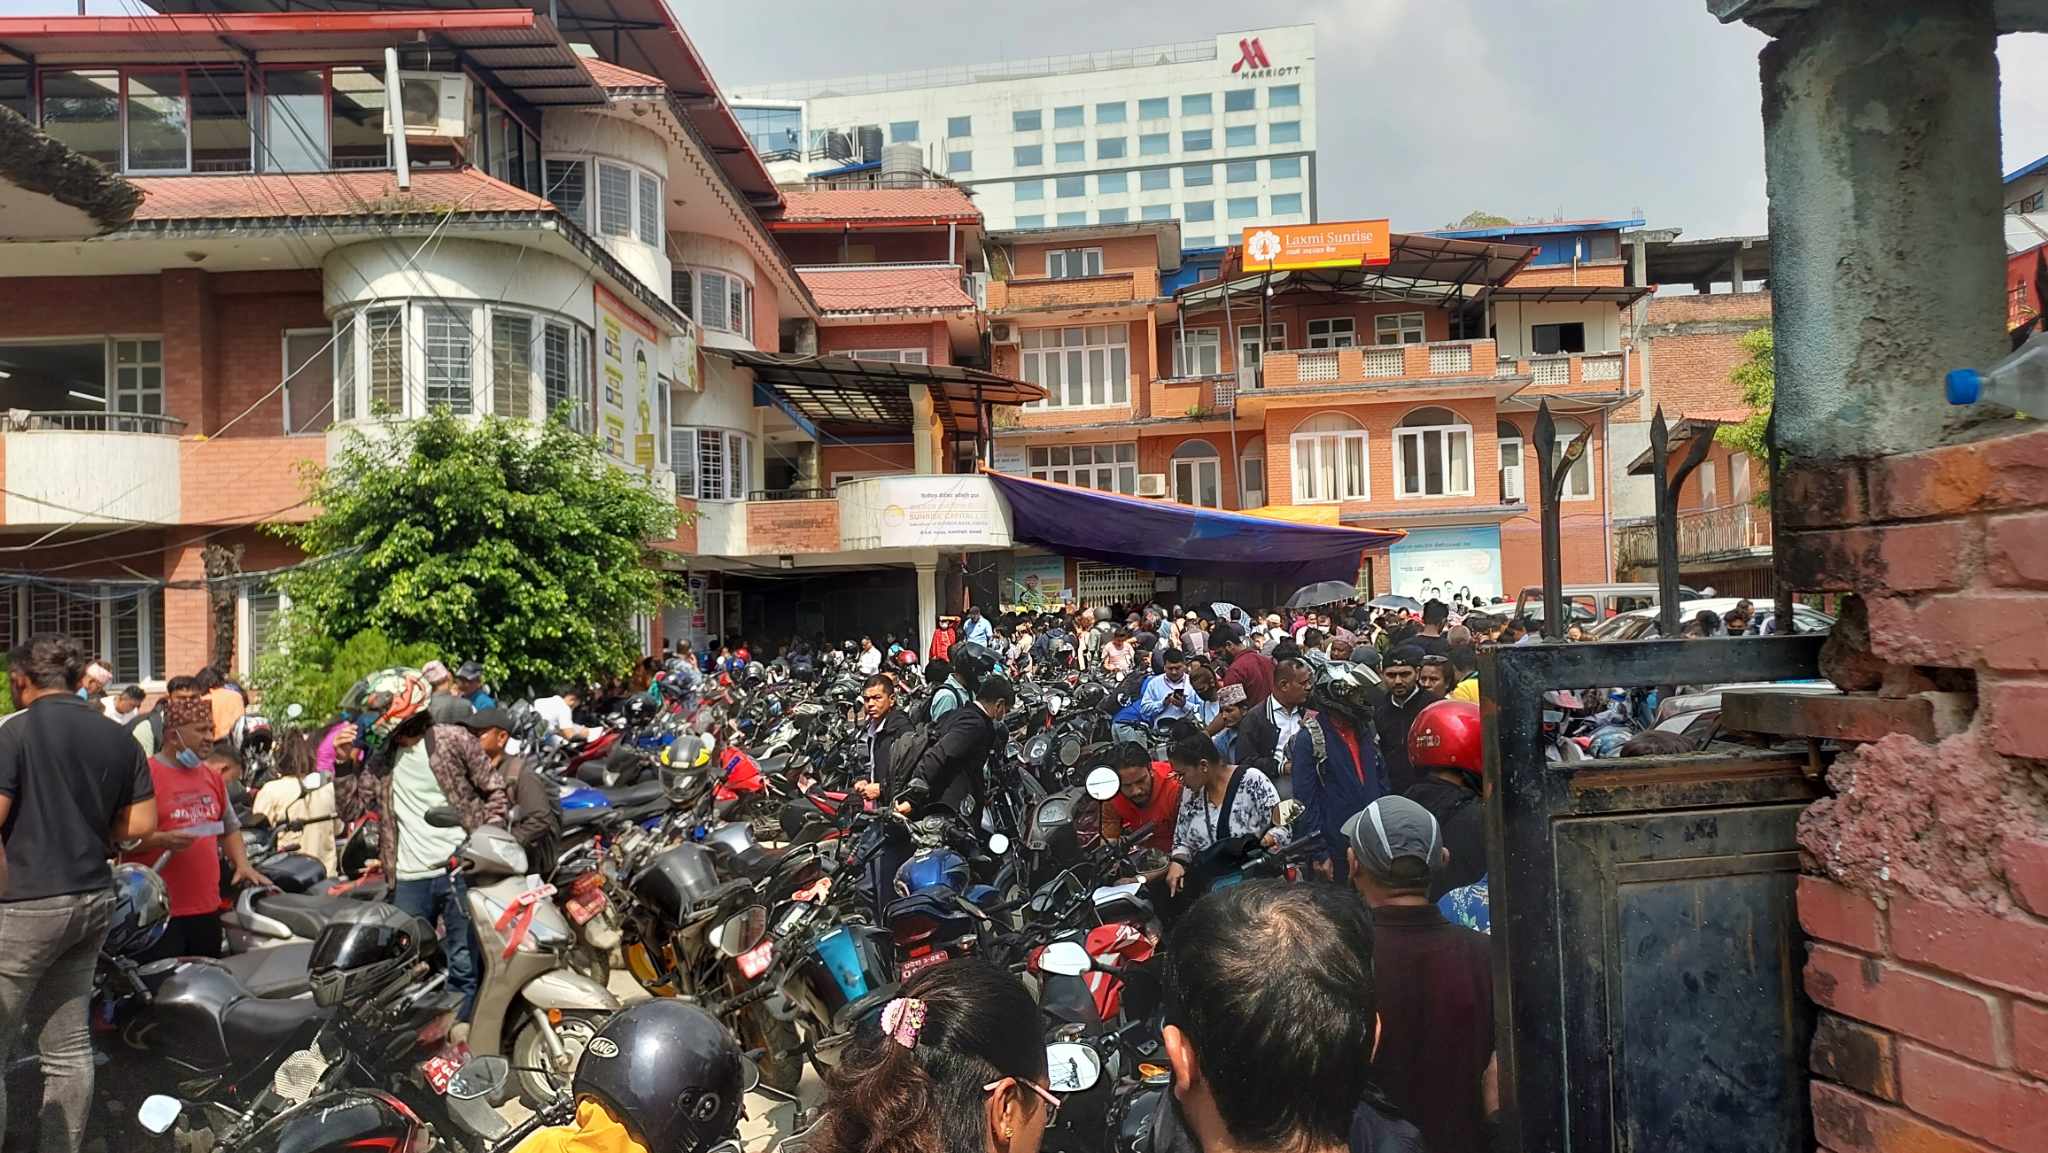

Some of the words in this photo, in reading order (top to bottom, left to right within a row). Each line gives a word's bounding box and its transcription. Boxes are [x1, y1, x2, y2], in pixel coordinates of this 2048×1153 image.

[1241, 66, 1300, 79] MARRIOTT
[1286, 233, 1324, 245] Laxmi
[1327, 230, 1373, 243] Sunrise
